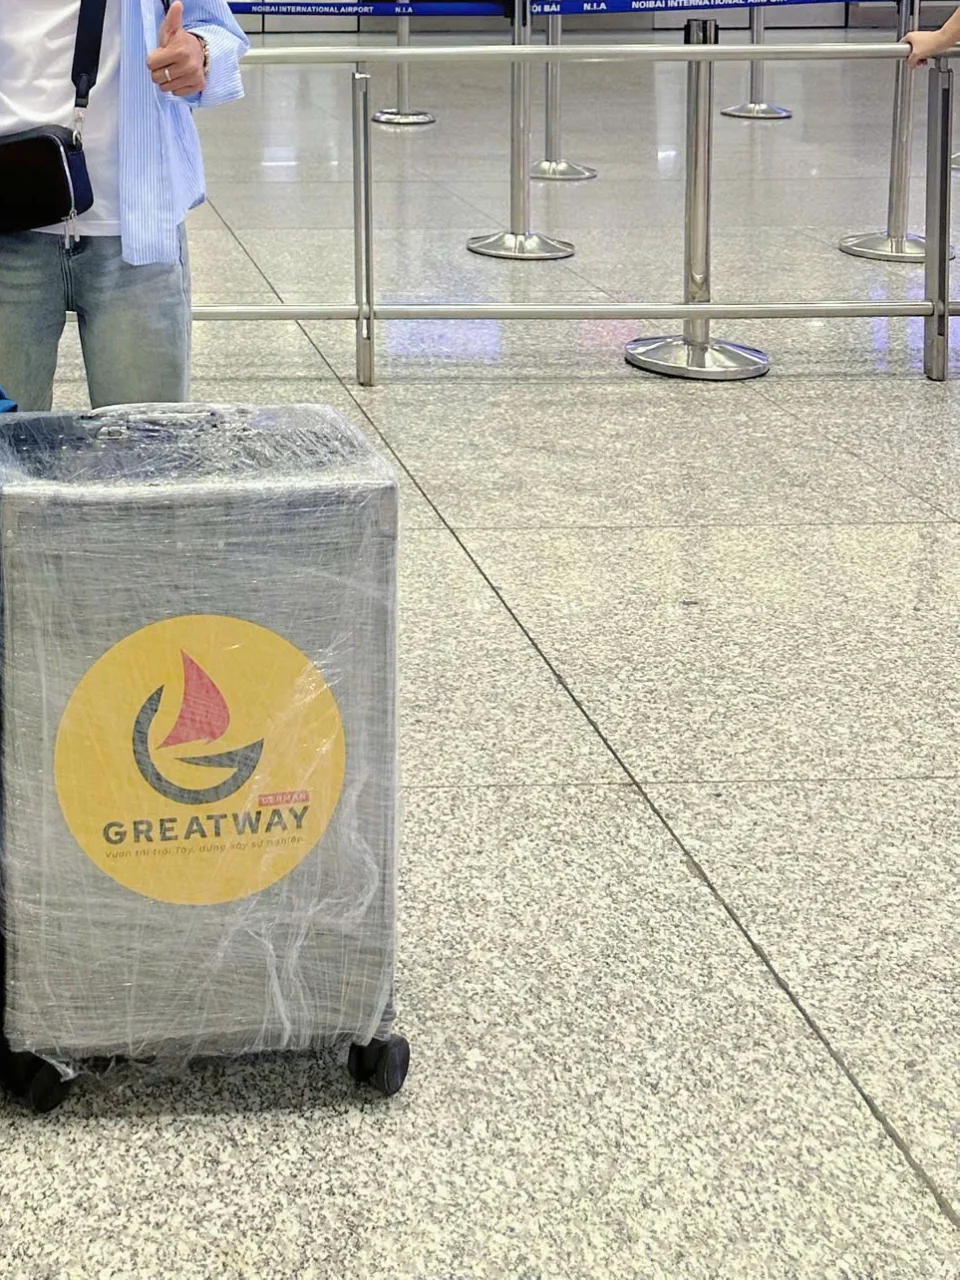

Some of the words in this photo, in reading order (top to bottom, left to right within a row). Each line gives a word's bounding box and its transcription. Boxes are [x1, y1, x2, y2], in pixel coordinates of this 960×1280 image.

[544, 4, 560, 12] BÀI
[584, 2, 606, 10] N.I.A
[632, 0, 666, 8] NOIBAI
[262, 794, 306, 805] GERMAN
[103, 806, 309, 845] GREATWAY
